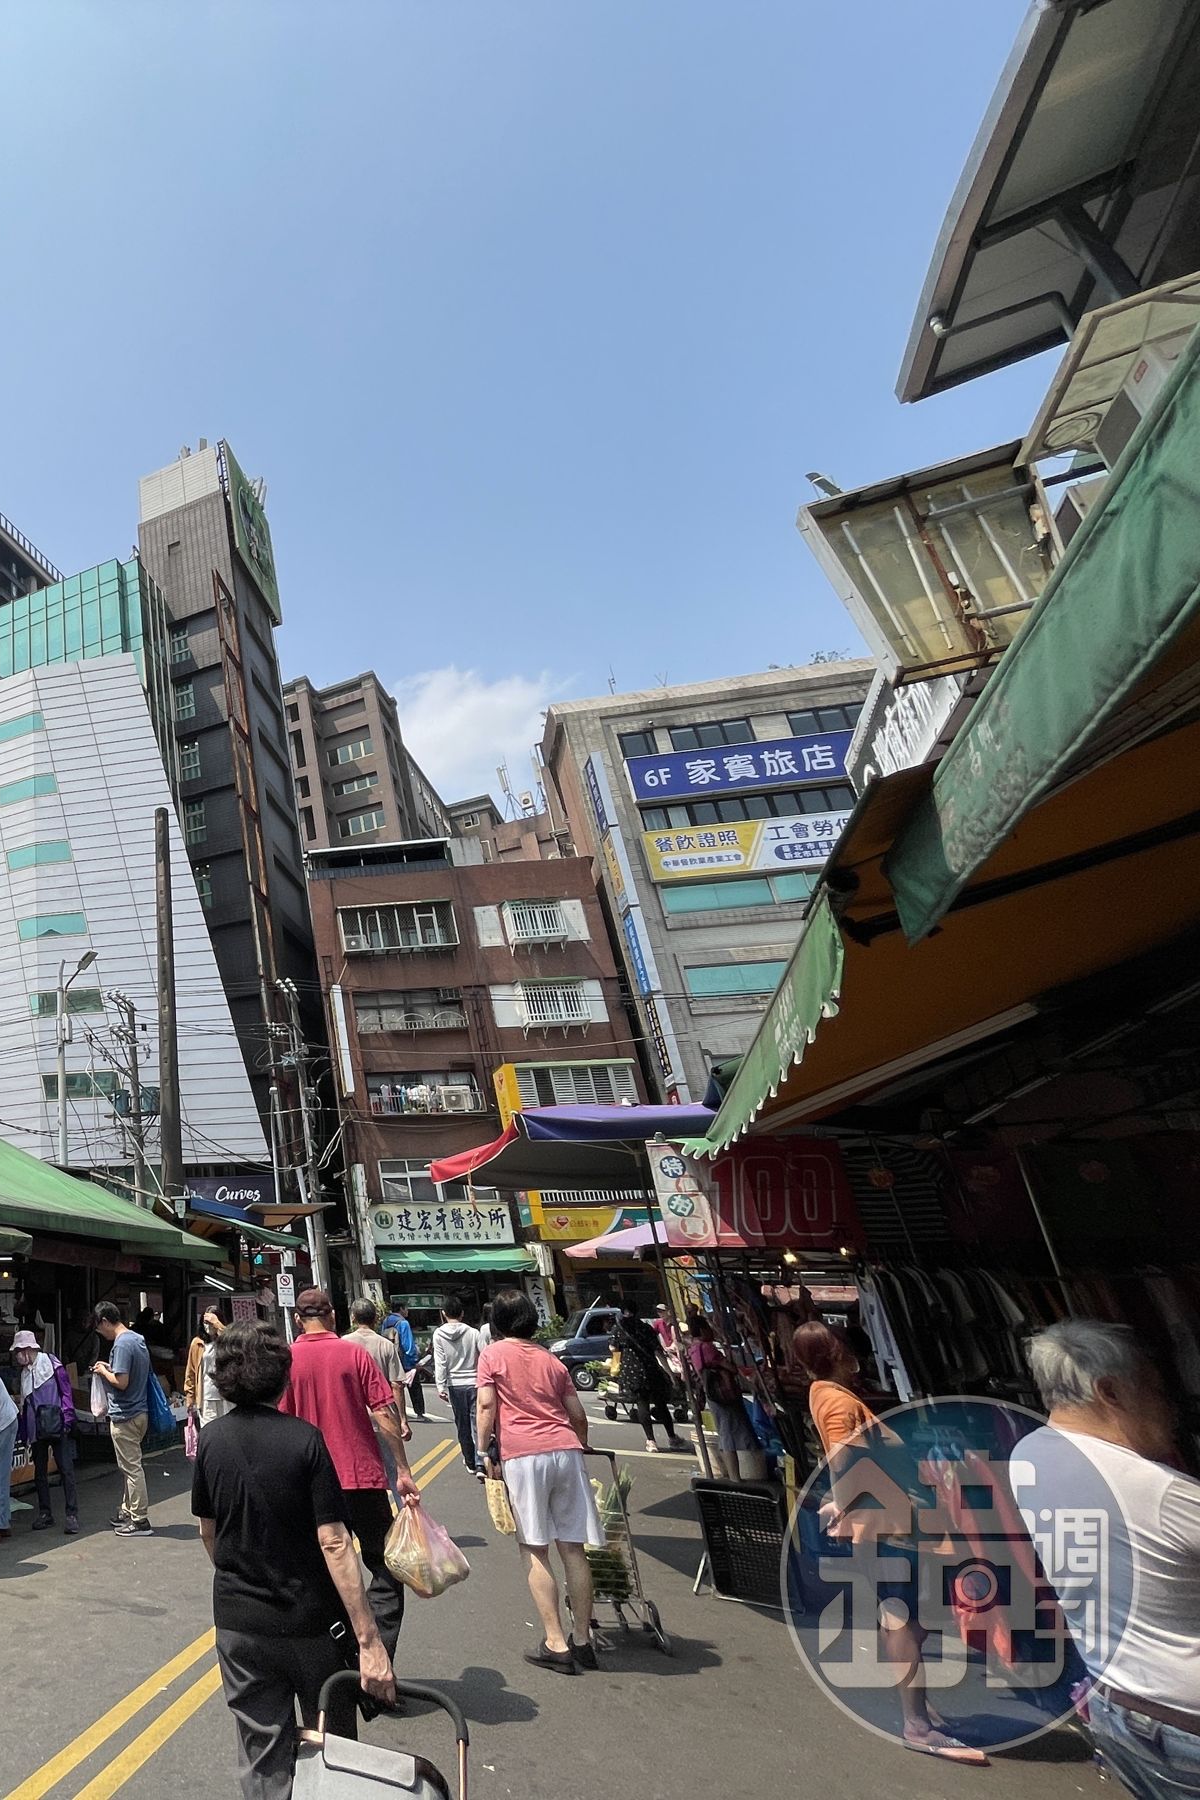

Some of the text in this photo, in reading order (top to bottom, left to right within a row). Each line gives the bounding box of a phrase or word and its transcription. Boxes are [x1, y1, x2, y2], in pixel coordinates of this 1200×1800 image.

[644, 744, 836, 788] 6F 家賓旅店
[655, 830, 740, 853] 餐飲證照
[215, 1186, 261, 1201] Curves
[708, 1155, 836, 1236] 100
[397, 1208, 506, 1232] 建宏牙醫診所
